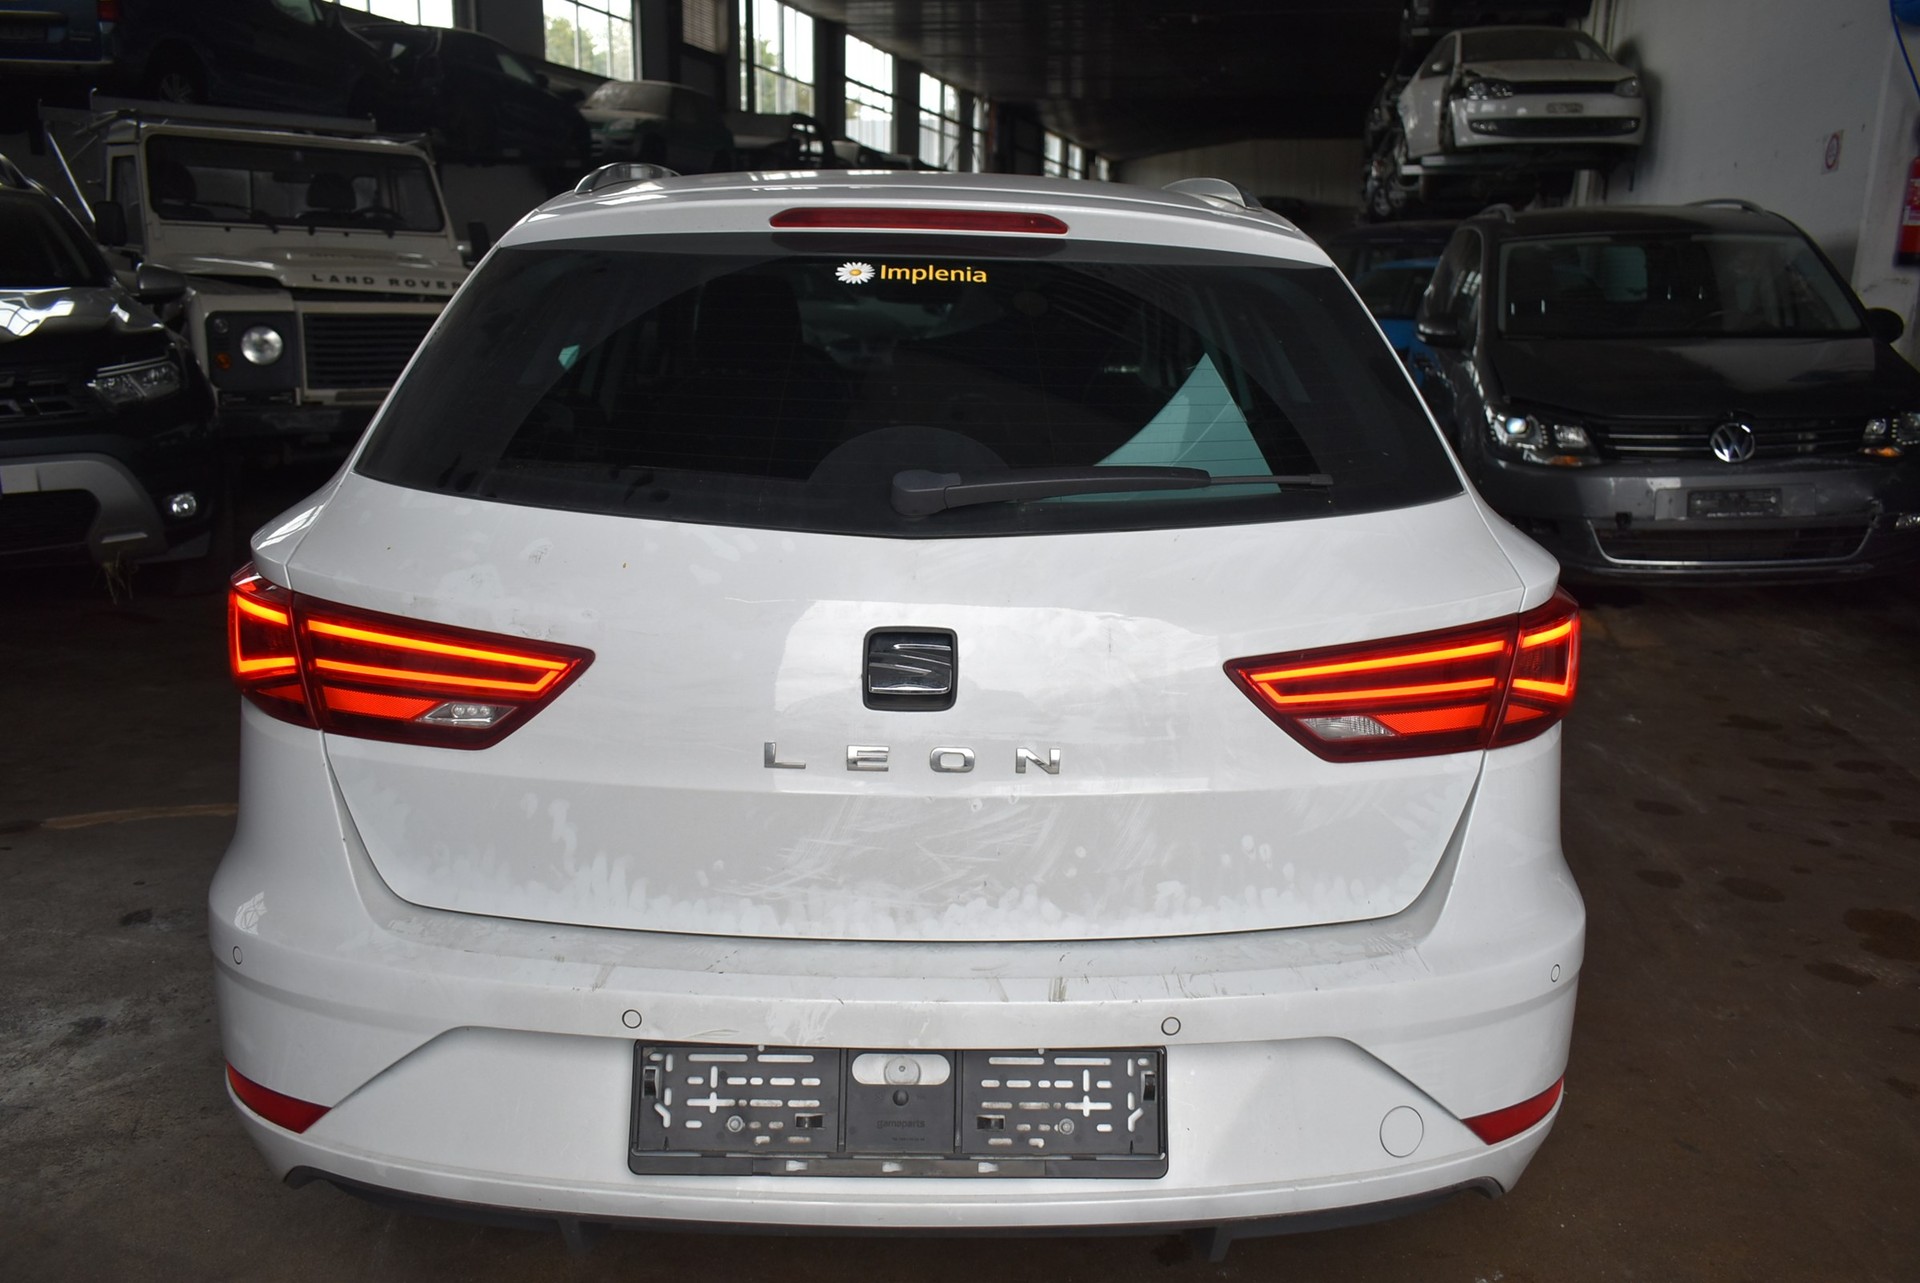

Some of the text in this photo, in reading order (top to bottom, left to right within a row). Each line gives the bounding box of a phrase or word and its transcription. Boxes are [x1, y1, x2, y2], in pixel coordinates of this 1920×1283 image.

[312, 273, 375, 285] LAND
[880, 264, 987, 285] Implenia
[764, 741, 1061, 775] LEON
